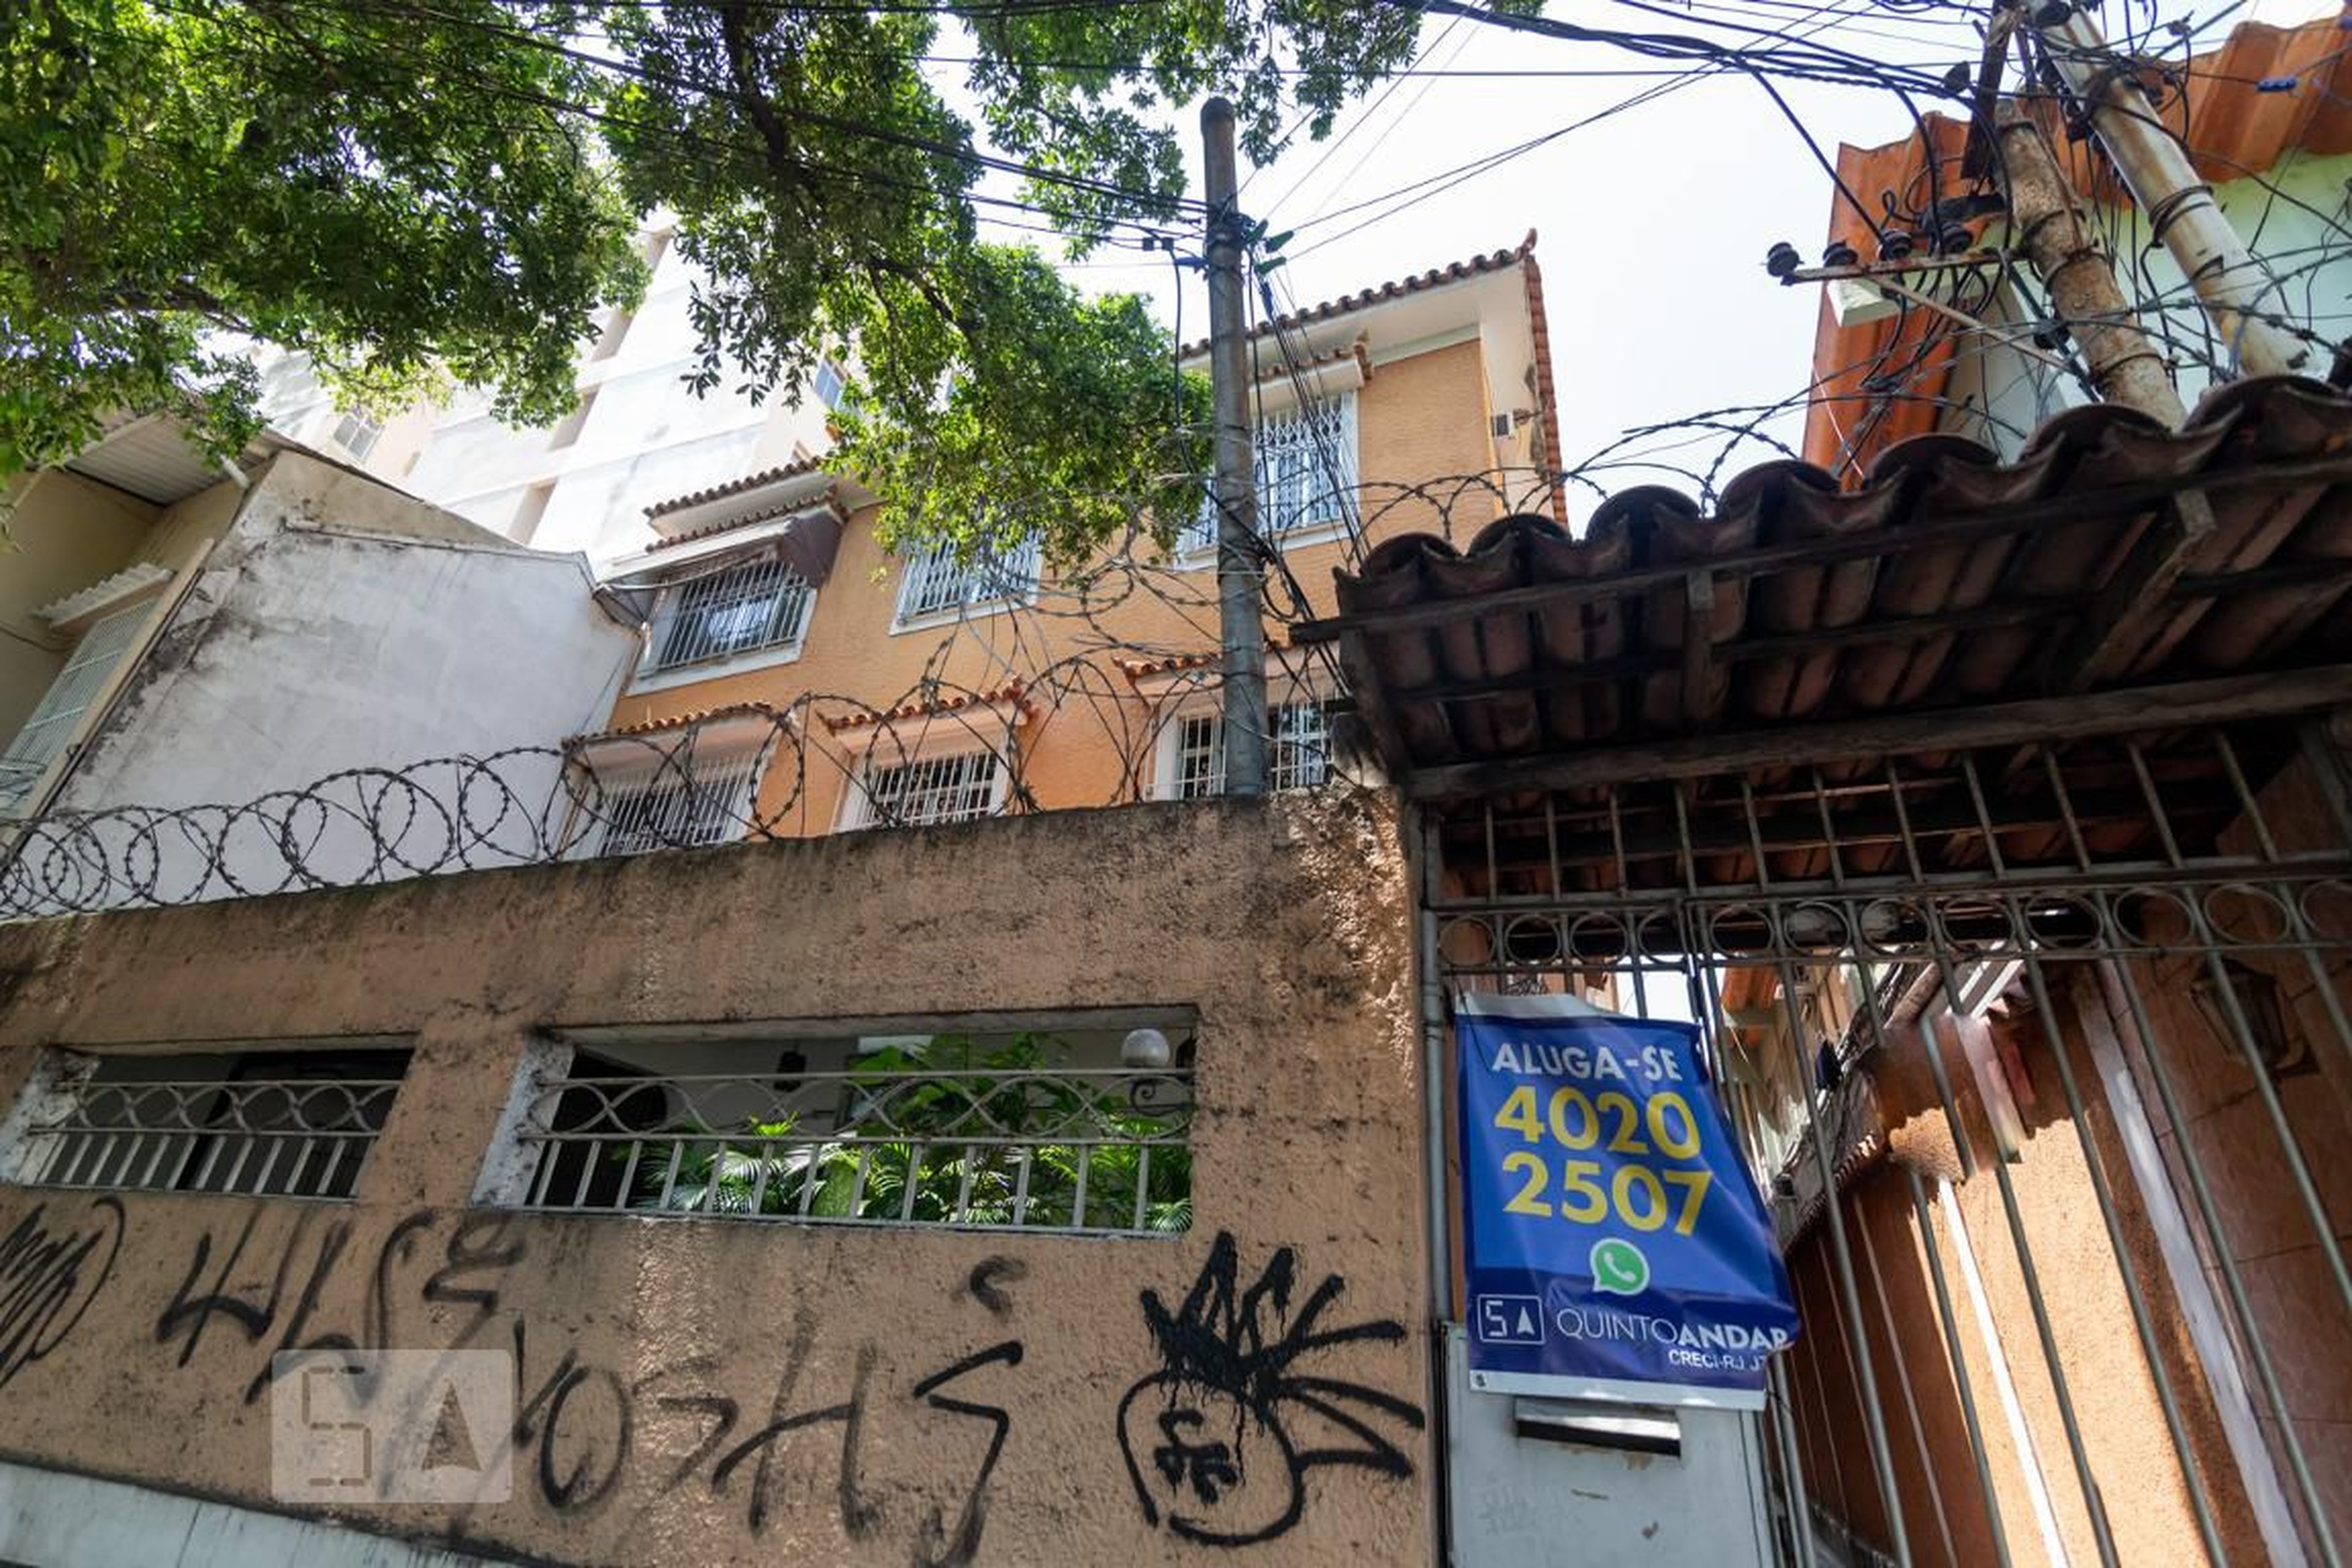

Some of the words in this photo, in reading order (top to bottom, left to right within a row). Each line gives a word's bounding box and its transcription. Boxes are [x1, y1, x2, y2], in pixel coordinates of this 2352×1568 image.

[1492, 1043, 1683, 1081] ALUGA-SE
[1494, 1086, 1701, 1159] 4020
[1502, 1152, 1713, 1236] 2507
